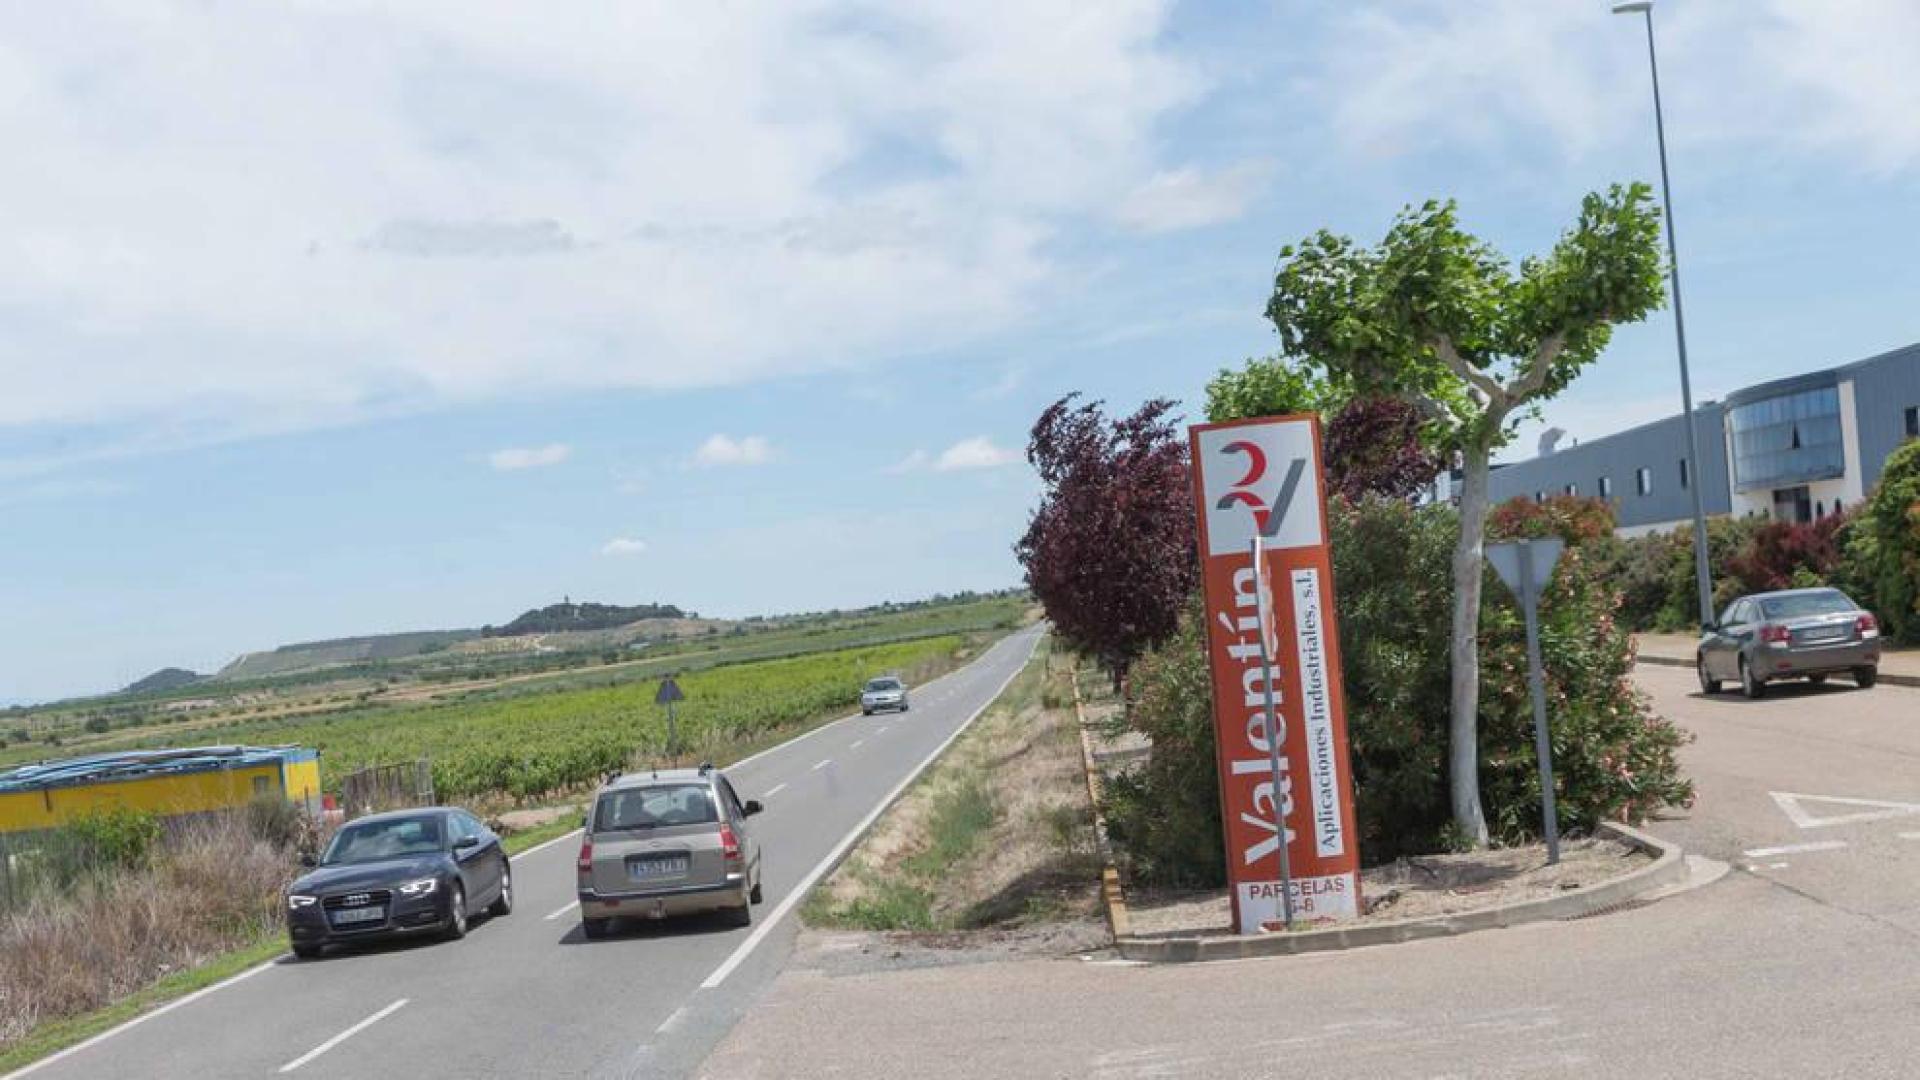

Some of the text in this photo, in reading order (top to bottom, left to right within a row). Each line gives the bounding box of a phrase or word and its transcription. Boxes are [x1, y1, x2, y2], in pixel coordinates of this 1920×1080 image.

[1217, 567, 1297, 866] Valentín
[1301, 603, 1324, 721] Industriales,
[1315, 726, 1340, 849] Aplicaciones
[1249, 876, 1345, 901] PARCELAS
